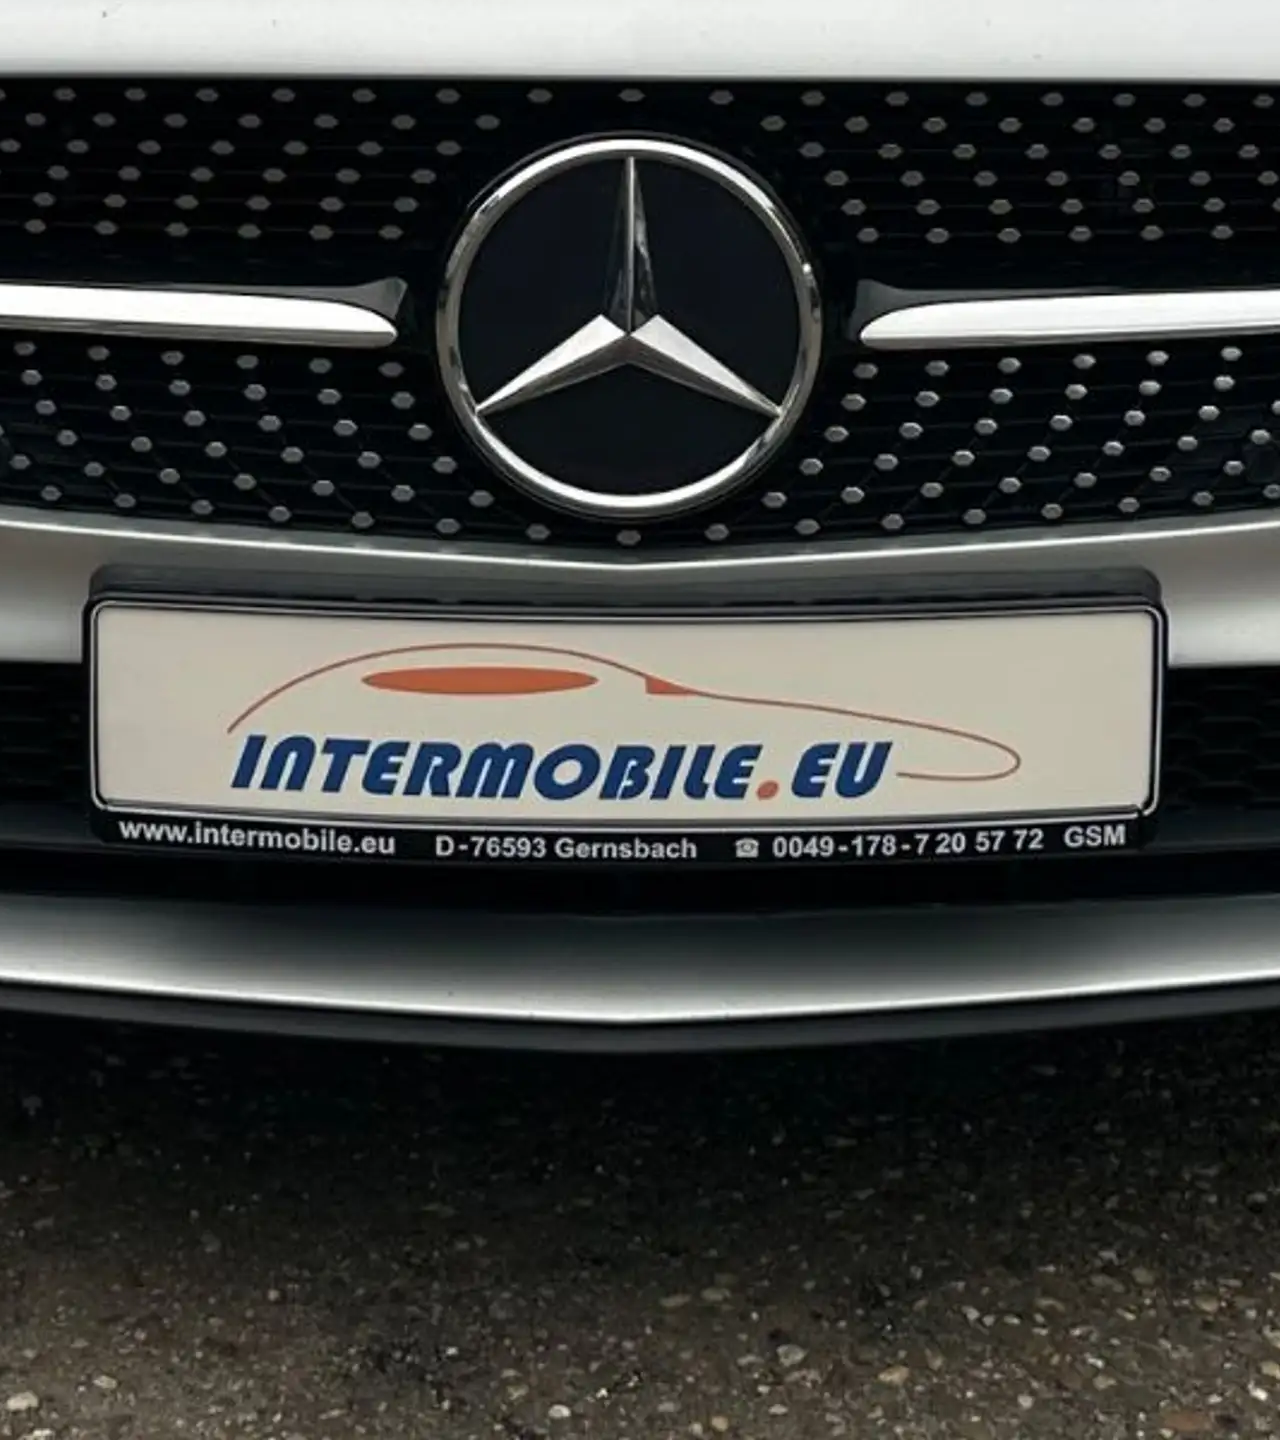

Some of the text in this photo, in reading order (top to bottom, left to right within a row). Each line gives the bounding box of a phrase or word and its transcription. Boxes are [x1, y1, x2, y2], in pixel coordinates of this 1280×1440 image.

[231, 734, 893, 801] INTERMOBILE.EU
[119, 819, 396, 855] www.intermobile.eu
[435, 834, 547, 858] D-76593
[554, 836, 698, 859] Gernsbach
[1063, 823, 1126, 848] GSM
